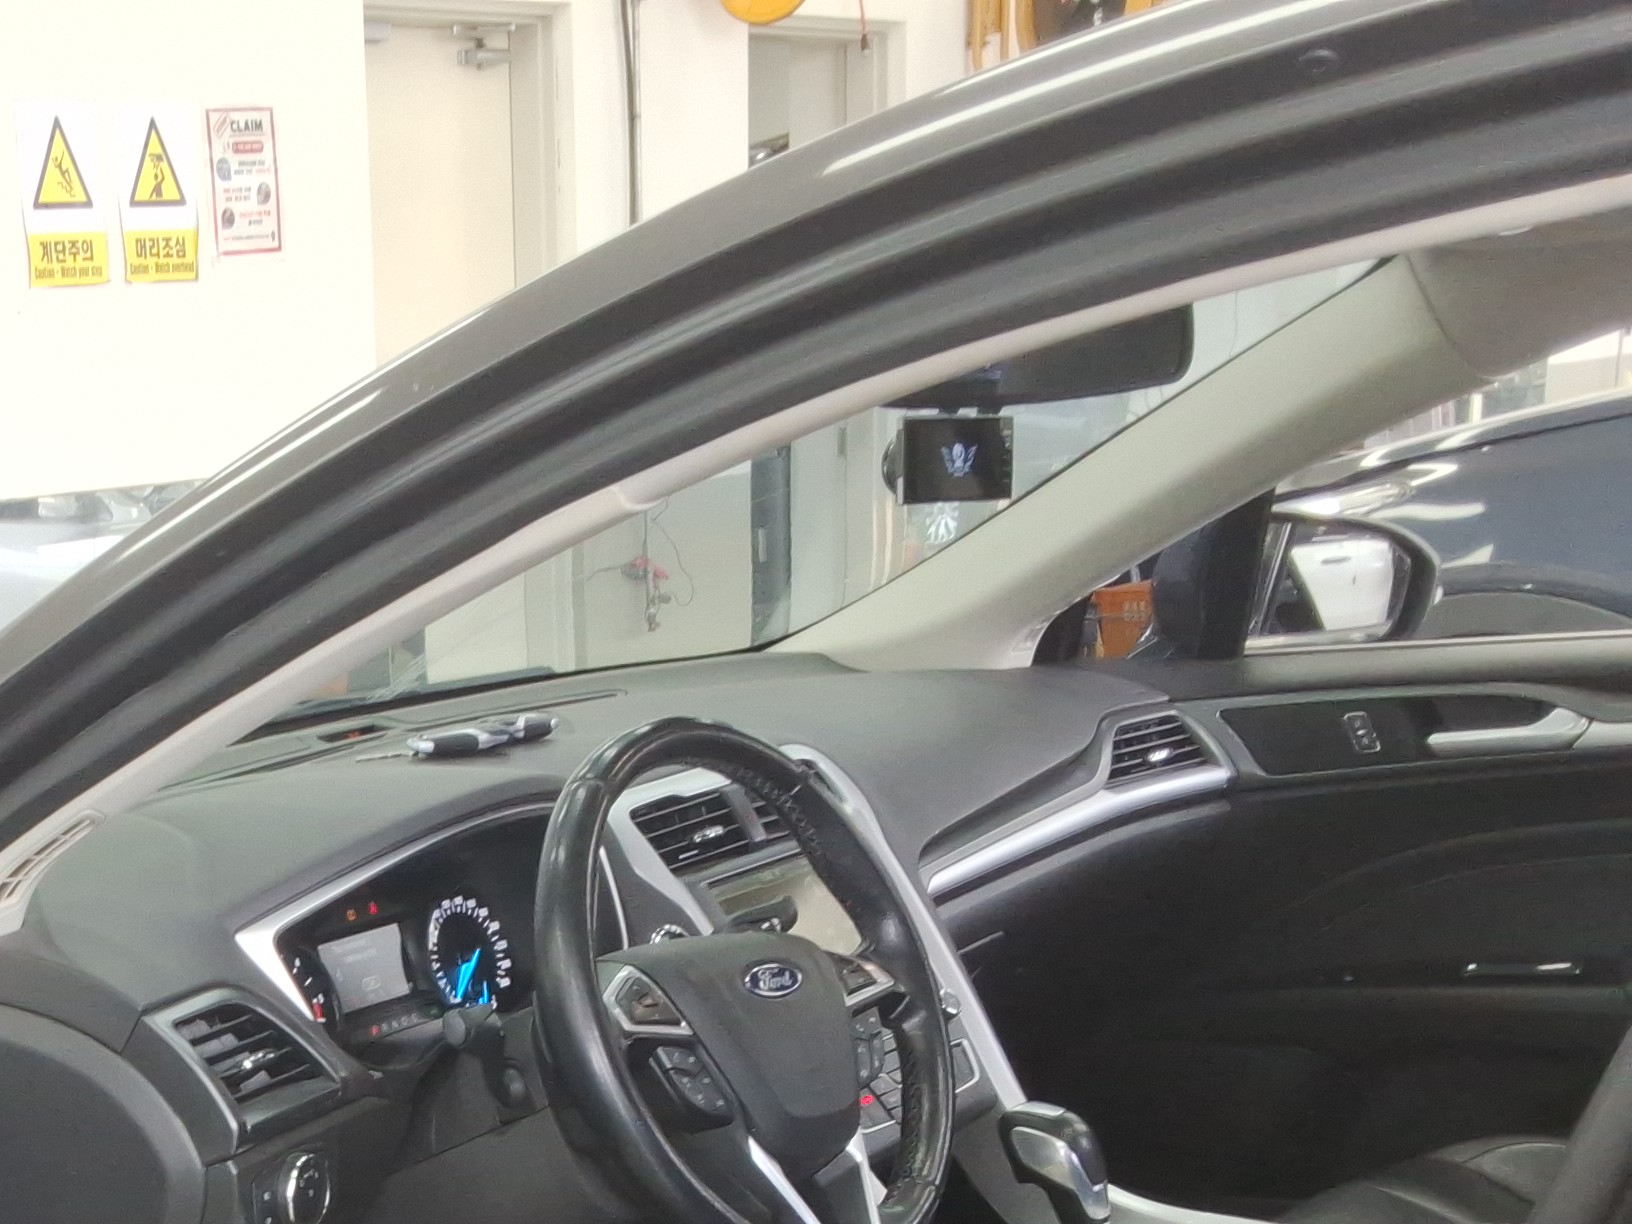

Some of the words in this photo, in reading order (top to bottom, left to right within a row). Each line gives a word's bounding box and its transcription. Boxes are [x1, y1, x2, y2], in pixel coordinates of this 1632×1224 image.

[230, 119, 264, 132] CLAIM
[39, 240, 94, 264] 계단주의
[135, 236, 186, 259] 머리조심
[758, 969, 793, 990] Ford
